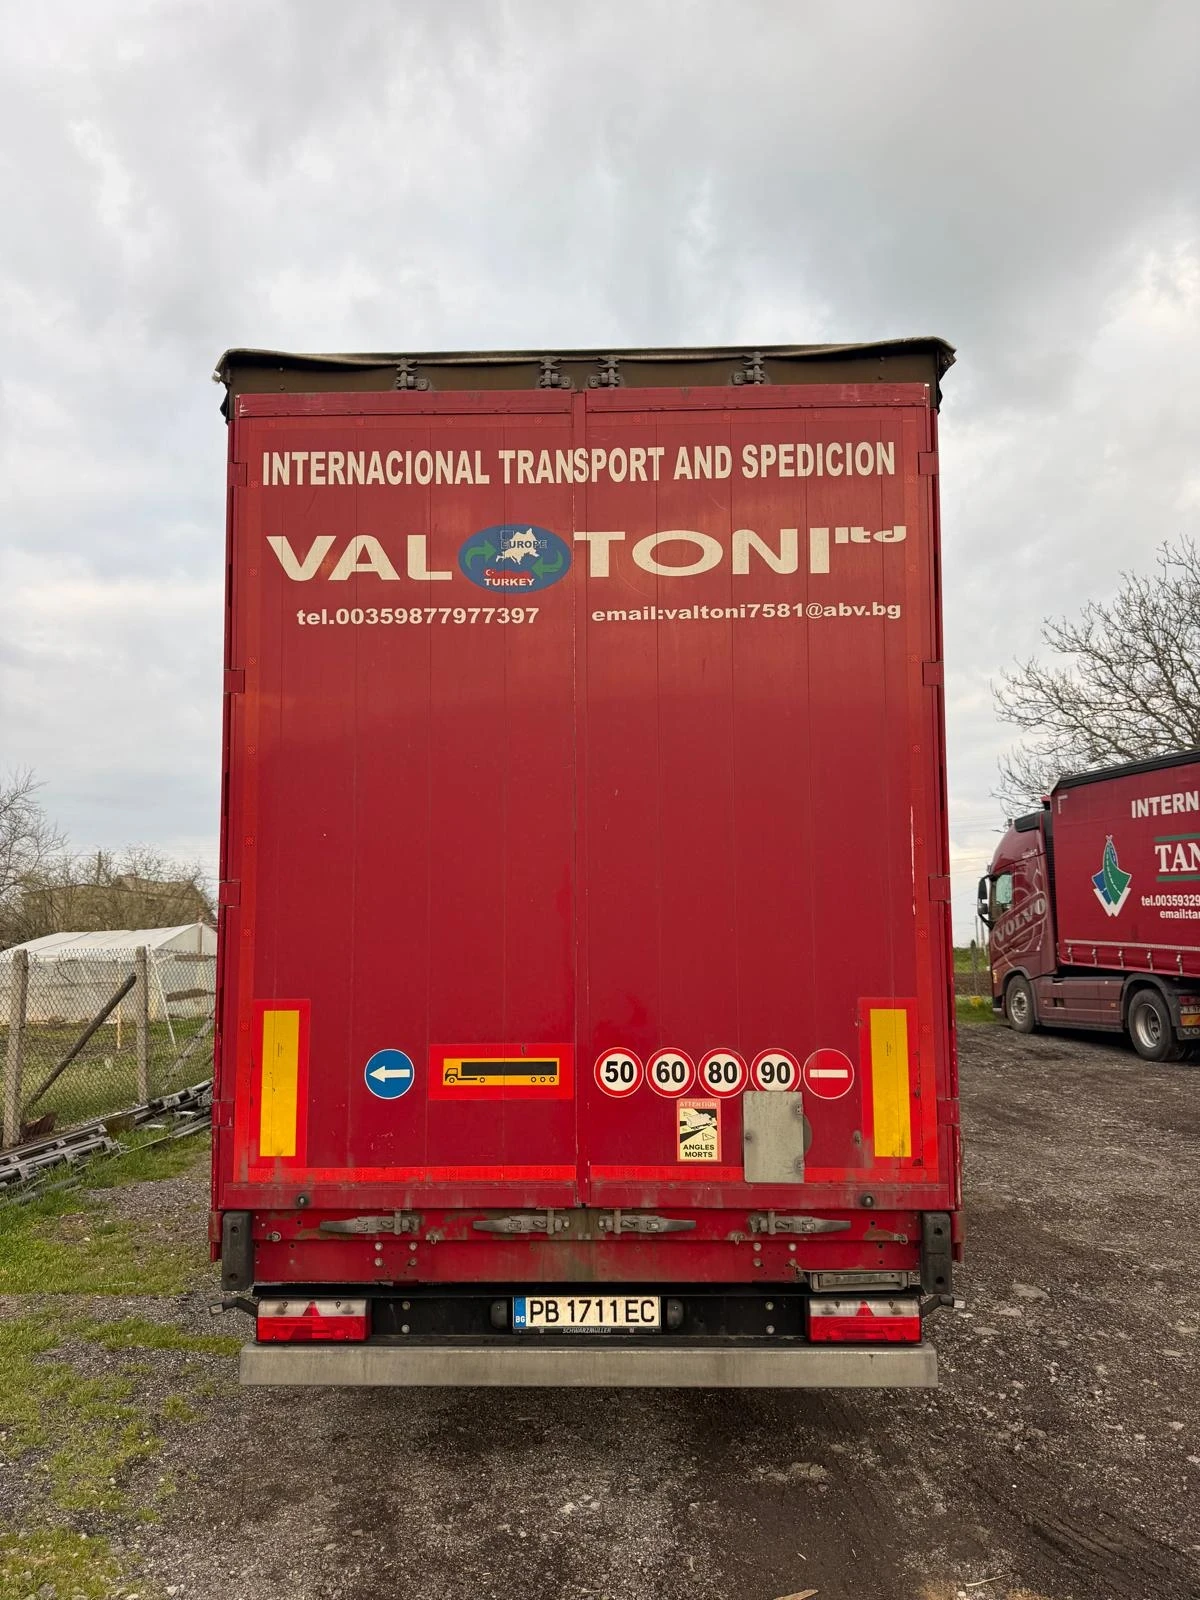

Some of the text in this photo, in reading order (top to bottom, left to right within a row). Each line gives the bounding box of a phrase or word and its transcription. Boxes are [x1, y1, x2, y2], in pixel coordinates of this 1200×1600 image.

[262, 441, 895, 486] INTERNACIONAL TRANSPORT AND SPEDICION
[266, 525, 907, 581] VAL TONI ltd
[499, 538, 548, 550] EUROPE
[484, 578, 535, 587] TURKEY
[296, 607, 540, 626] tel.00359877977397
[591, 602, 902, 623] email:valtoni7581@abv.bg
[995, 898, 1046, 942] VOLVO
[604, 1060, 634, 1084] 50
[656, 1060, 685, 1083] 60
[708, 1061, 738, 1084] 80
[760, 1061, 791, 1084] 90
[515, 1315, 526, 1323] BG
